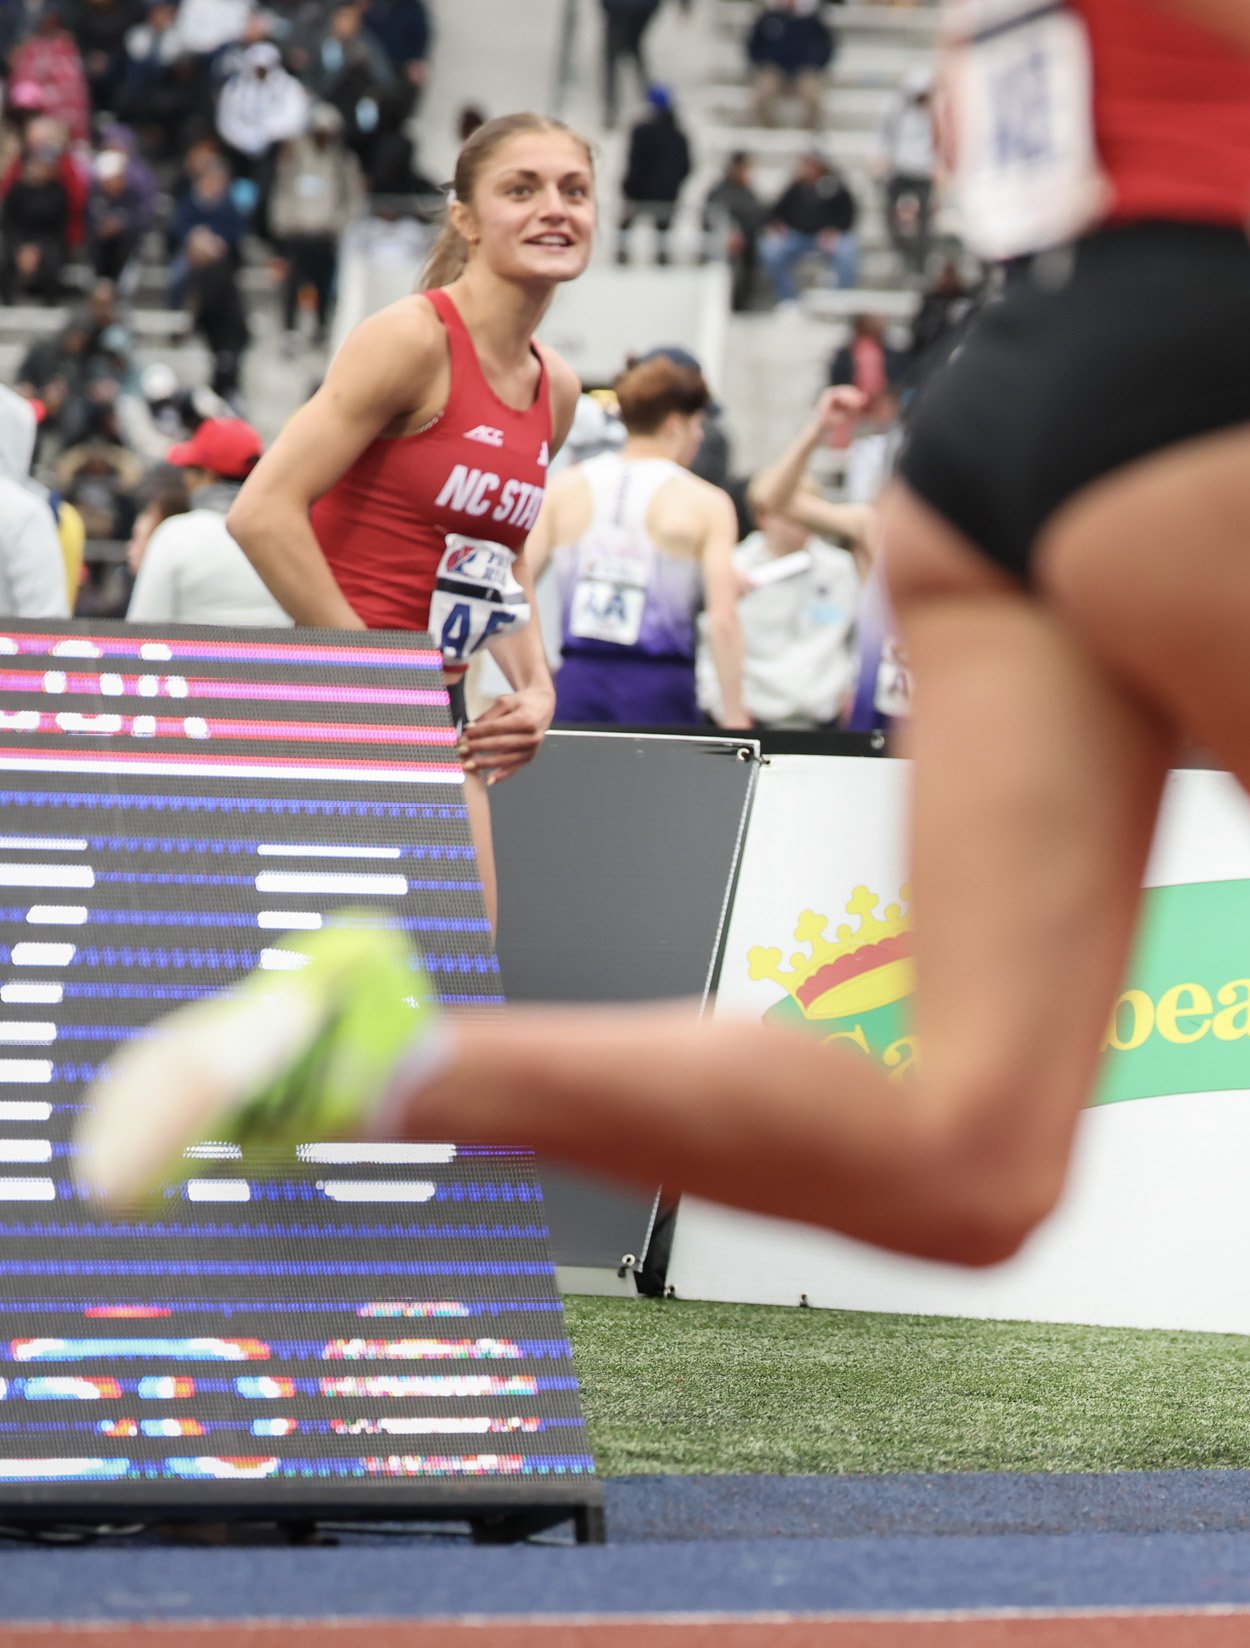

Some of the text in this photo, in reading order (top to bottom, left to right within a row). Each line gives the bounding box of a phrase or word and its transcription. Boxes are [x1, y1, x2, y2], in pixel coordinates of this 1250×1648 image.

[462, 424, 505, 448] ACC
[434, 463, 545, 531] NC STA
